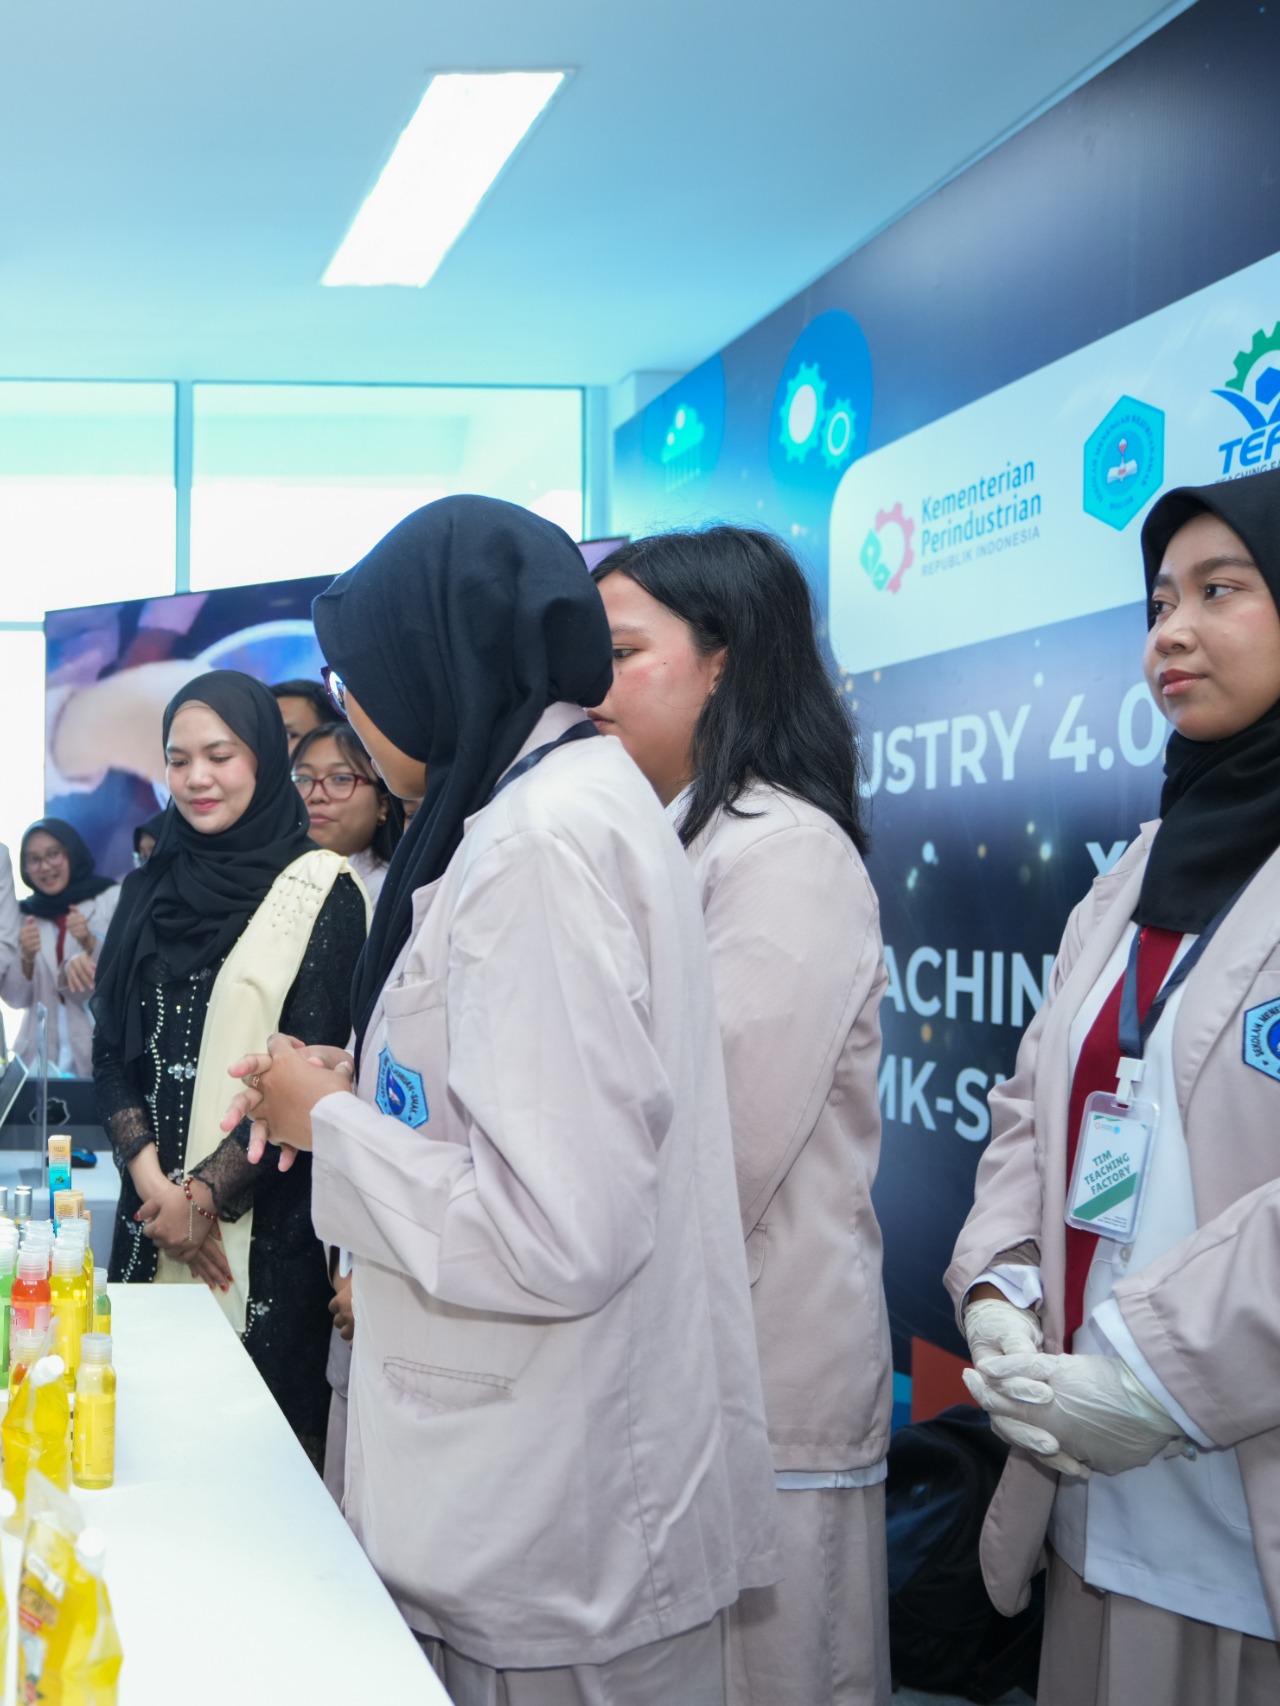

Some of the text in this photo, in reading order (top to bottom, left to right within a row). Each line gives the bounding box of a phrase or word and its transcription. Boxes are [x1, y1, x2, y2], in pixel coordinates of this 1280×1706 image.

[922, 461, 1035, 524] Kementerian
[921, 525, 1040, 577] REPUBLIK INDONESIA
[922, 493, 1041, 557] Perindustrian
[1049, 681, 1167, 772] 4.0
[1084, 1153, 1130, 1185] TEACHING
[1091, 1165, 1131, 1195] FACTORY
[1092, 1150, 1112, 1166] TIM
